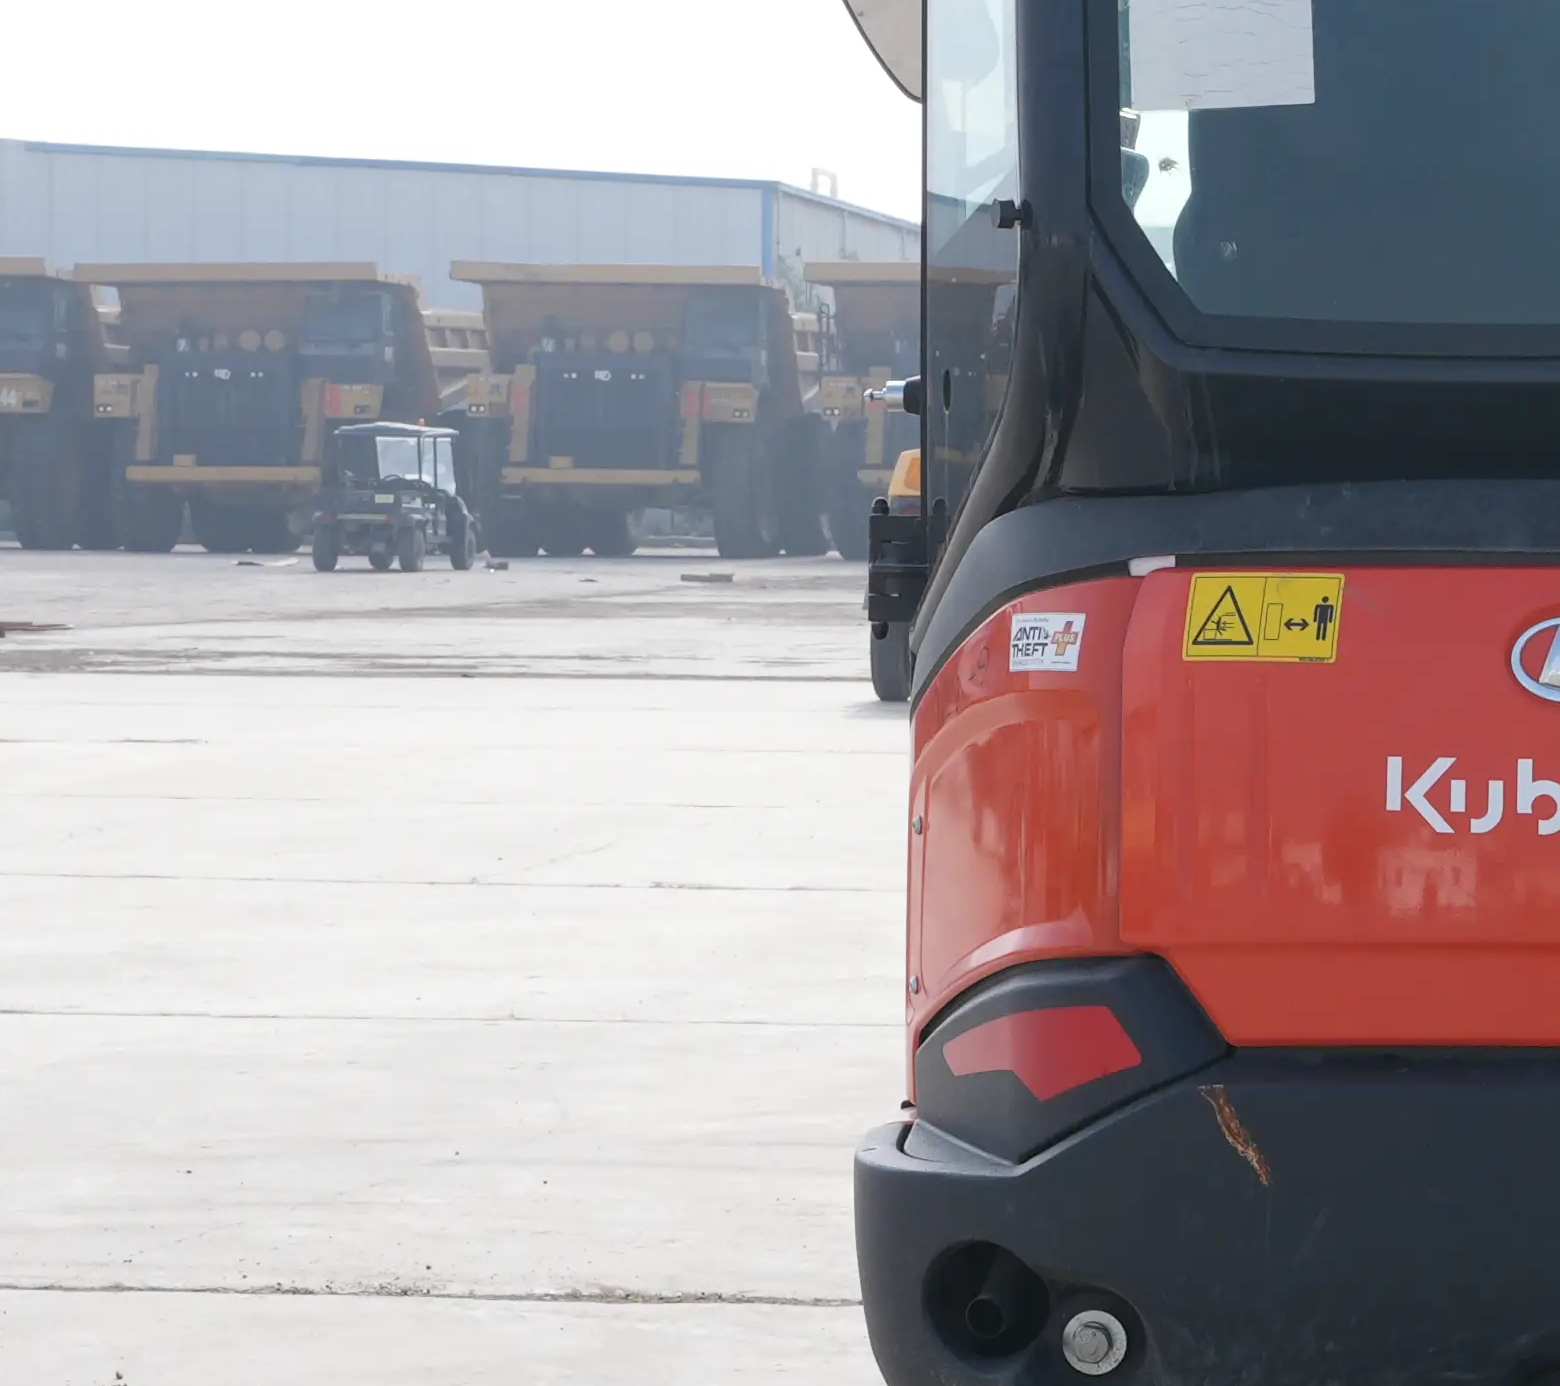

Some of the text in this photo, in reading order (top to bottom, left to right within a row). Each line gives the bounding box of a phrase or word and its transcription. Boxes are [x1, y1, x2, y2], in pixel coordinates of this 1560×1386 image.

[1013, 626, 1042, 641] ANTI
[1055, 633, 1075, 642] PLUS
[1012, 642, 1048, 658] THEFT
